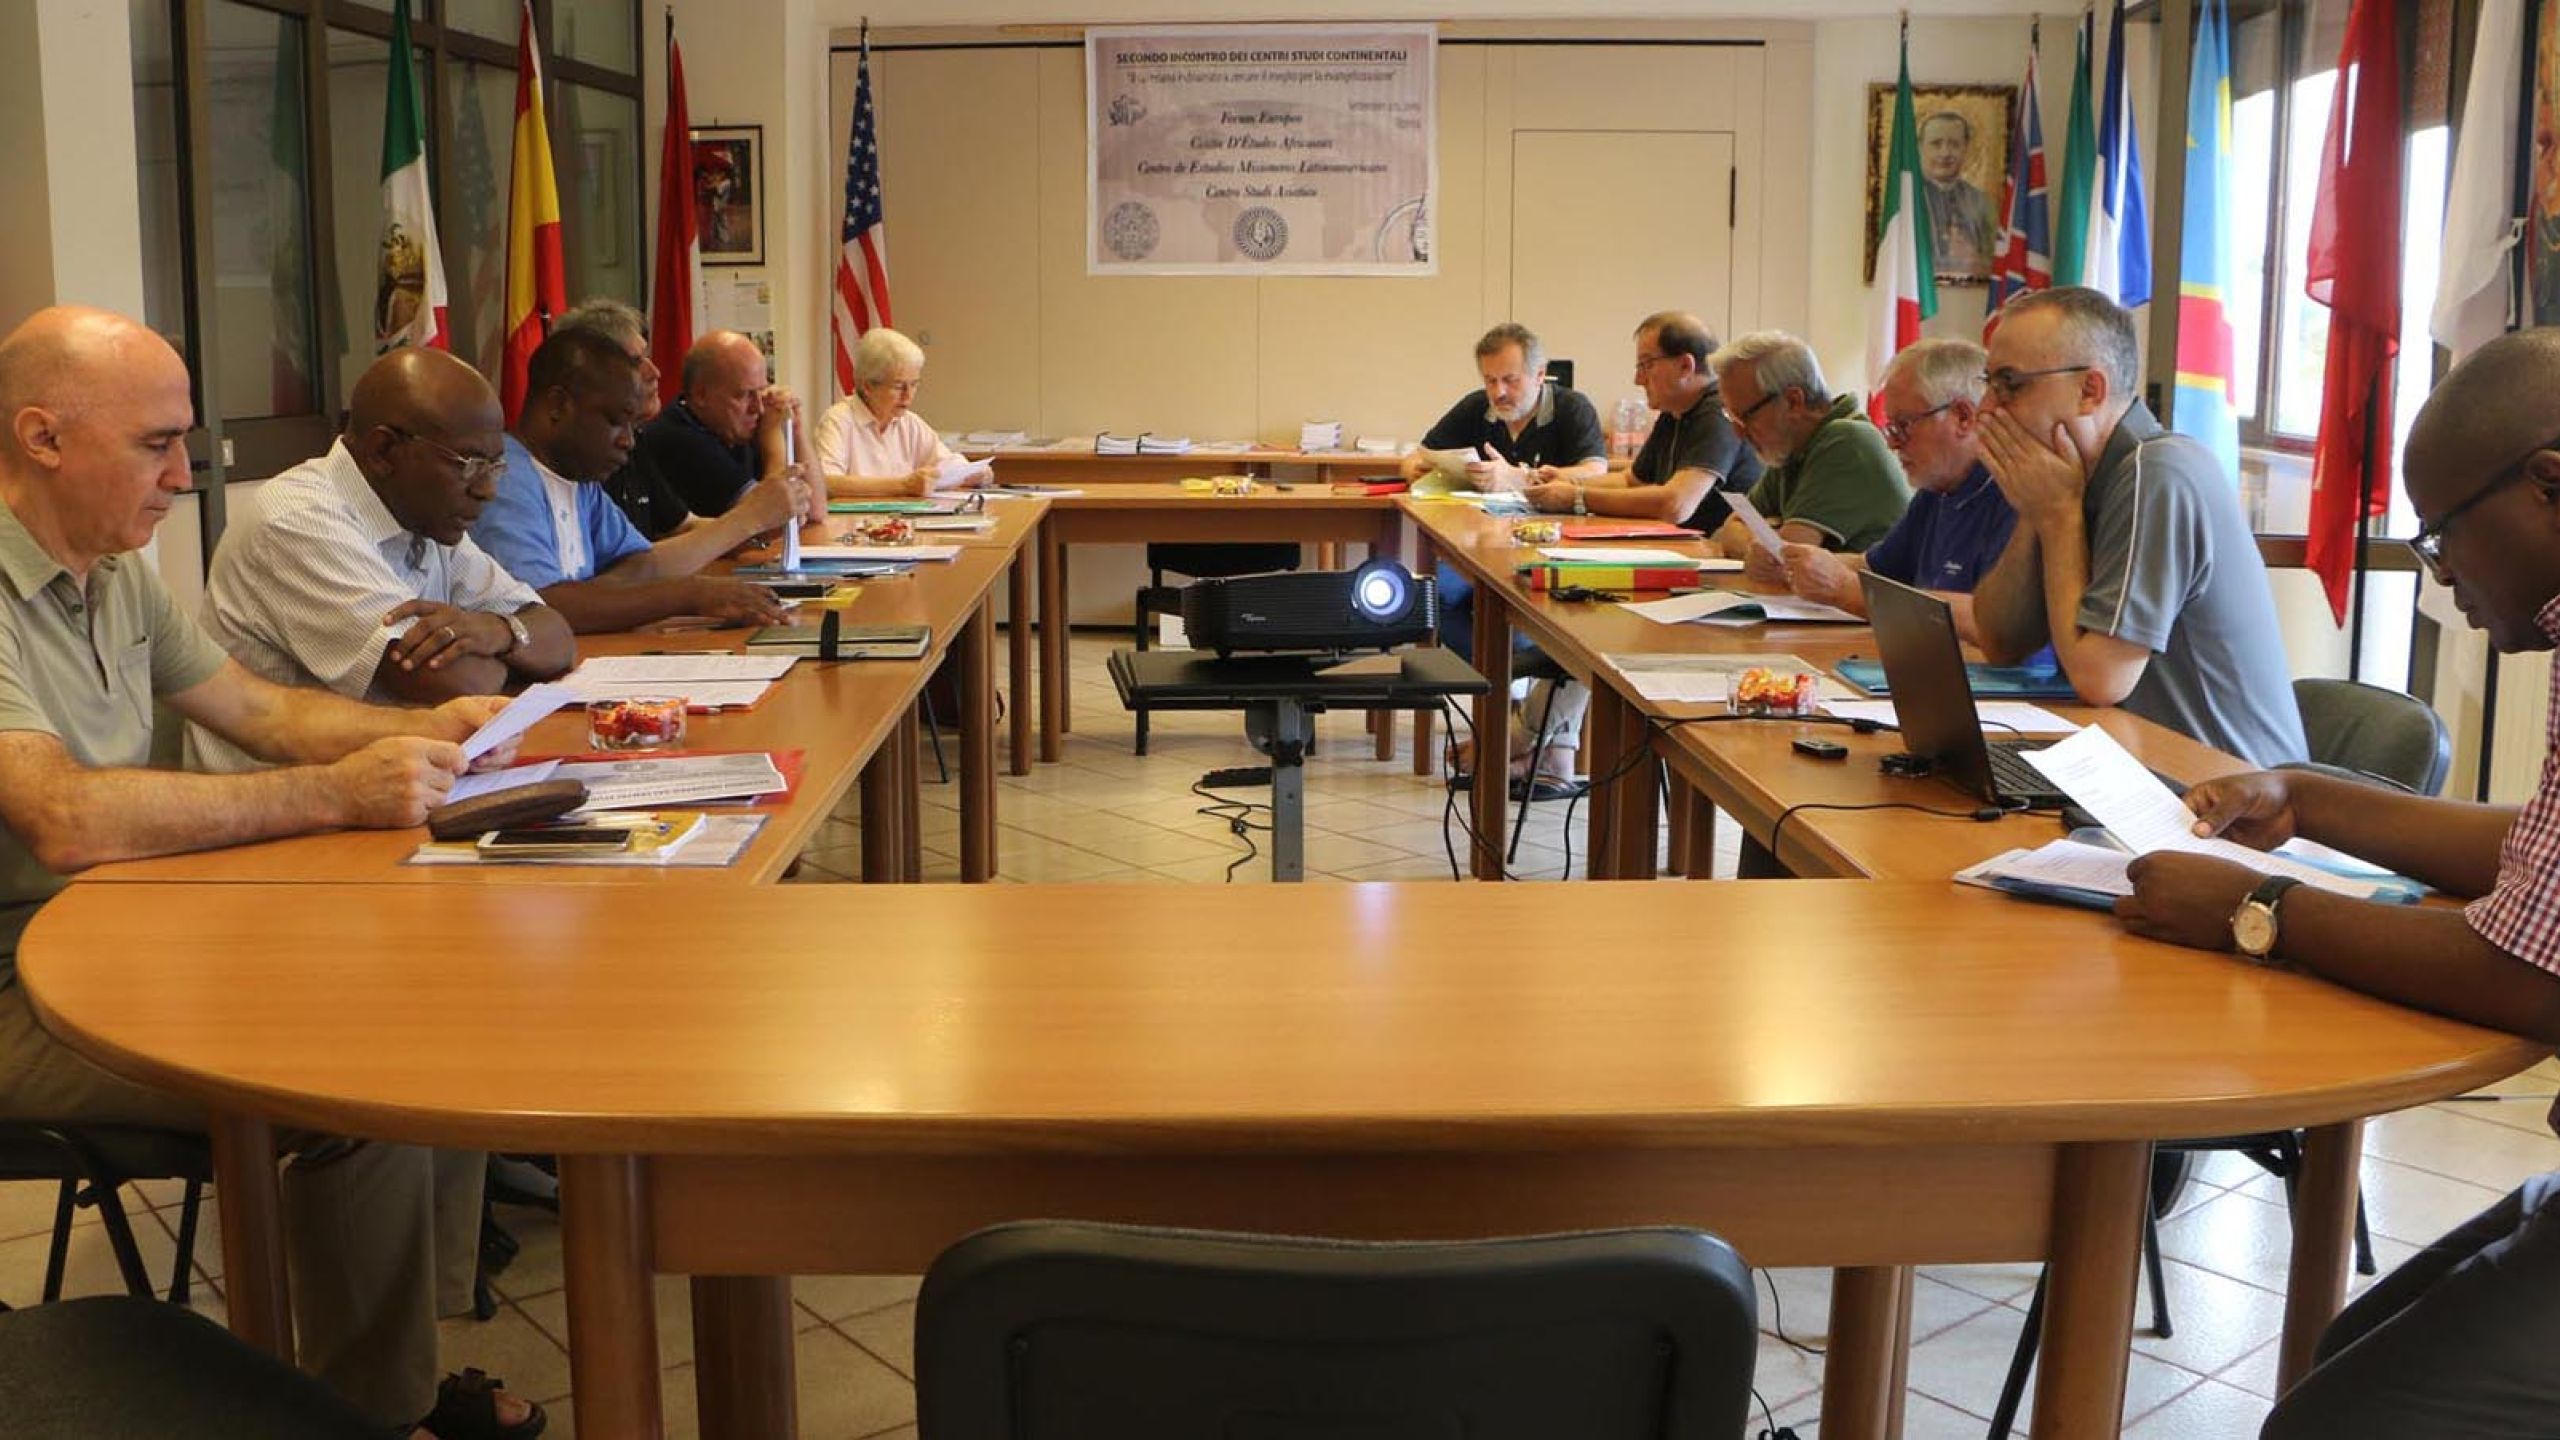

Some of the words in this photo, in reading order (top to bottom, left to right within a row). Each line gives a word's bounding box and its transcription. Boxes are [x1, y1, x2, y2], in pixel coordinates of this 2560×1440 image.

[1116, 52, 1168, 64] SECONDO
[1170, 51, 1227, 63] INCONTRO
[1229, 51, 1248, 62] DEI
[1250, 50, 1289, 62] CENTRI
[1291, 50, 1324, 61] STUDI
[1326, 50, 1407, 61] CONTINENTALI
